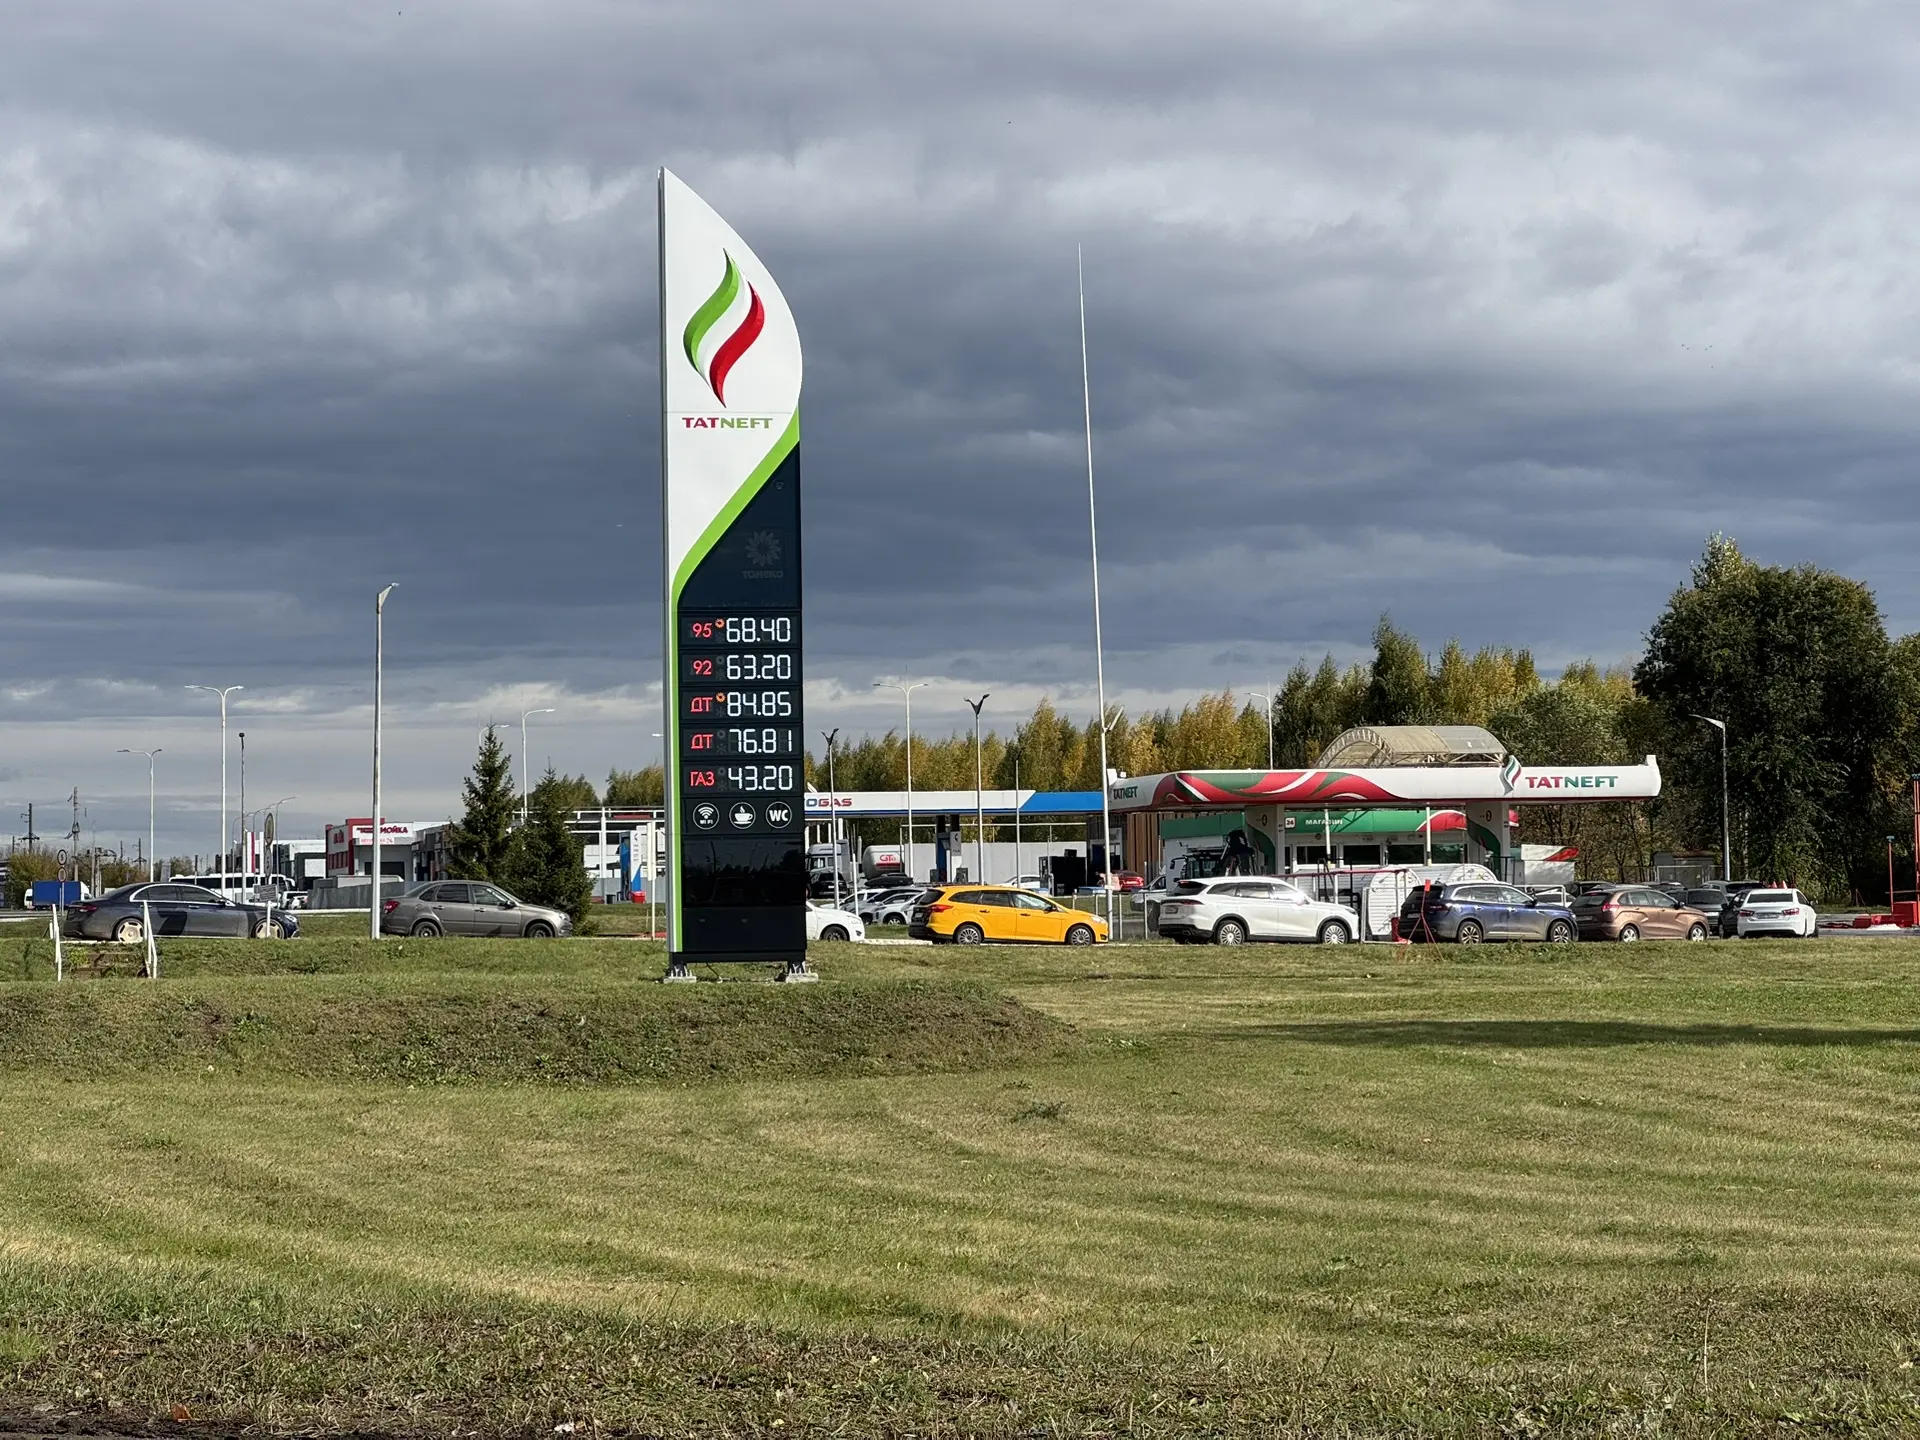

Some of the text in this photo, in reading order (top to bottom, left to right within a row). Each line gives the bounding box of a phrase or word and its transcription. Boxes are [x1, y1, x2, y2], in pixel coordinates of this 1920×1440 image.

[682, 417, 773, 429] TATNEFT
[692, 617, 791, 643] 95 68.40
[692, 654, 791, 680] 92 63.20
[690, 691, 792, 717] ДТ 84.85
[690, 728, 793, 754] ДТ 76.81
[690, 766, 793, 791] ГАЗ 43.20
[1525, 775, 1619, 789] TATNEFT
[805, 798, 853, 807] OGAS
[769, 809, 788, 822] WC
